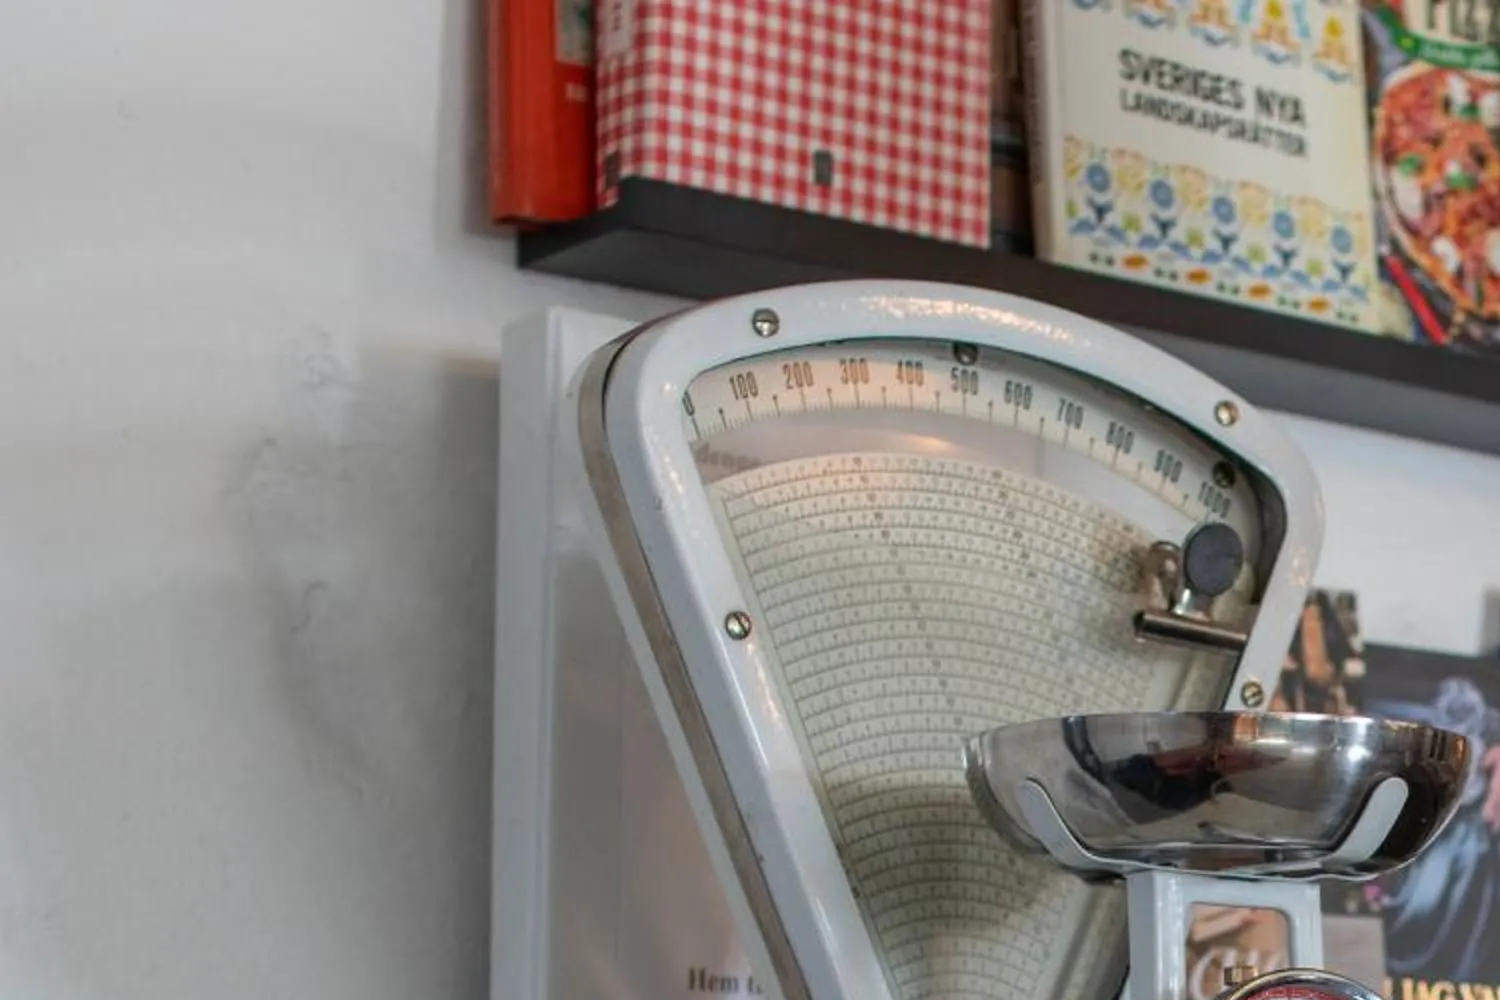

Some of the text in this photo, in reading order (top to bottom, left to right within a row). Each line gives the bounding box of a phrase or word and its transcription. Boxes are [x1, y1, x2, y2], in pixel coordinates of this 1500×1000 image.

[1119, 48, 1309, 128] SVERIGES NYA
[730, 371, 759, 400] 100
[783, 361, 814, 389] 200
[840, 358, 870, 385] 300
[896, 360, 925, 387] 400
[951, 367, 979, 396] 500
[1004, 379, 1033, 411] 600
[1057, 398, 1083, 431] 700
[1106, 420, 1134, 455] 800
[1155, 449, 1183, 484] 900
[1199, 481, 1231, 520] 1000
[687, 966, 741, 993] Hem
